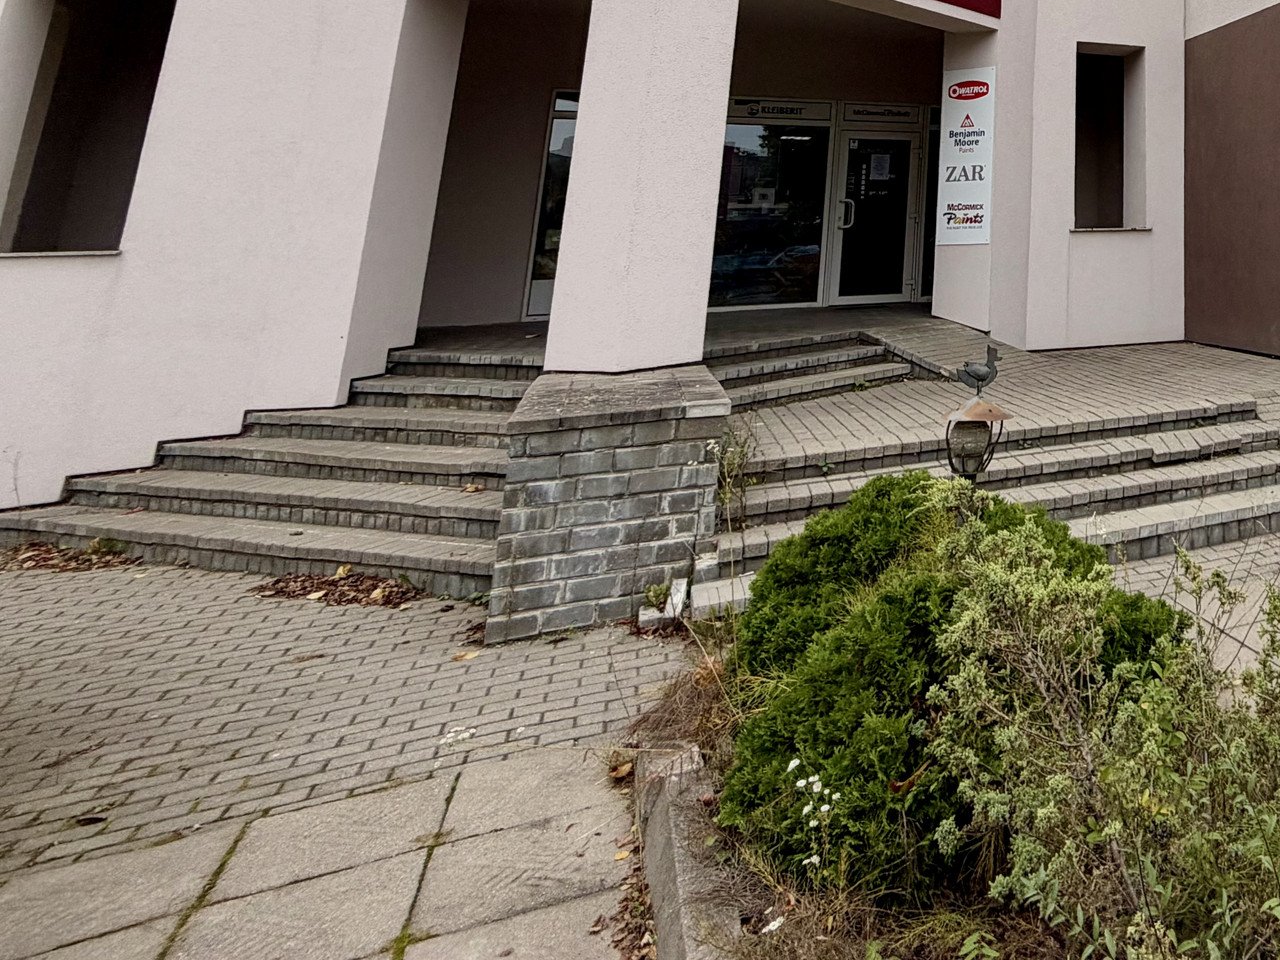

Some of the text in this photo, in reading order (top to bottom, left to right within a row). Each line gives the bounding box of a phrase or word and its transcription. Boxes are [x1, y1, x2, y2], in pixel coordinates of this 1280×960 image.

[950, 85, 988, 98] OWATROL
[949, 128, 986, 139] Benjamin
[954, 138, 980, 147] Moore
[945, 164, 985, 182] ZAR
[943, 212, 984, 225] Paints
